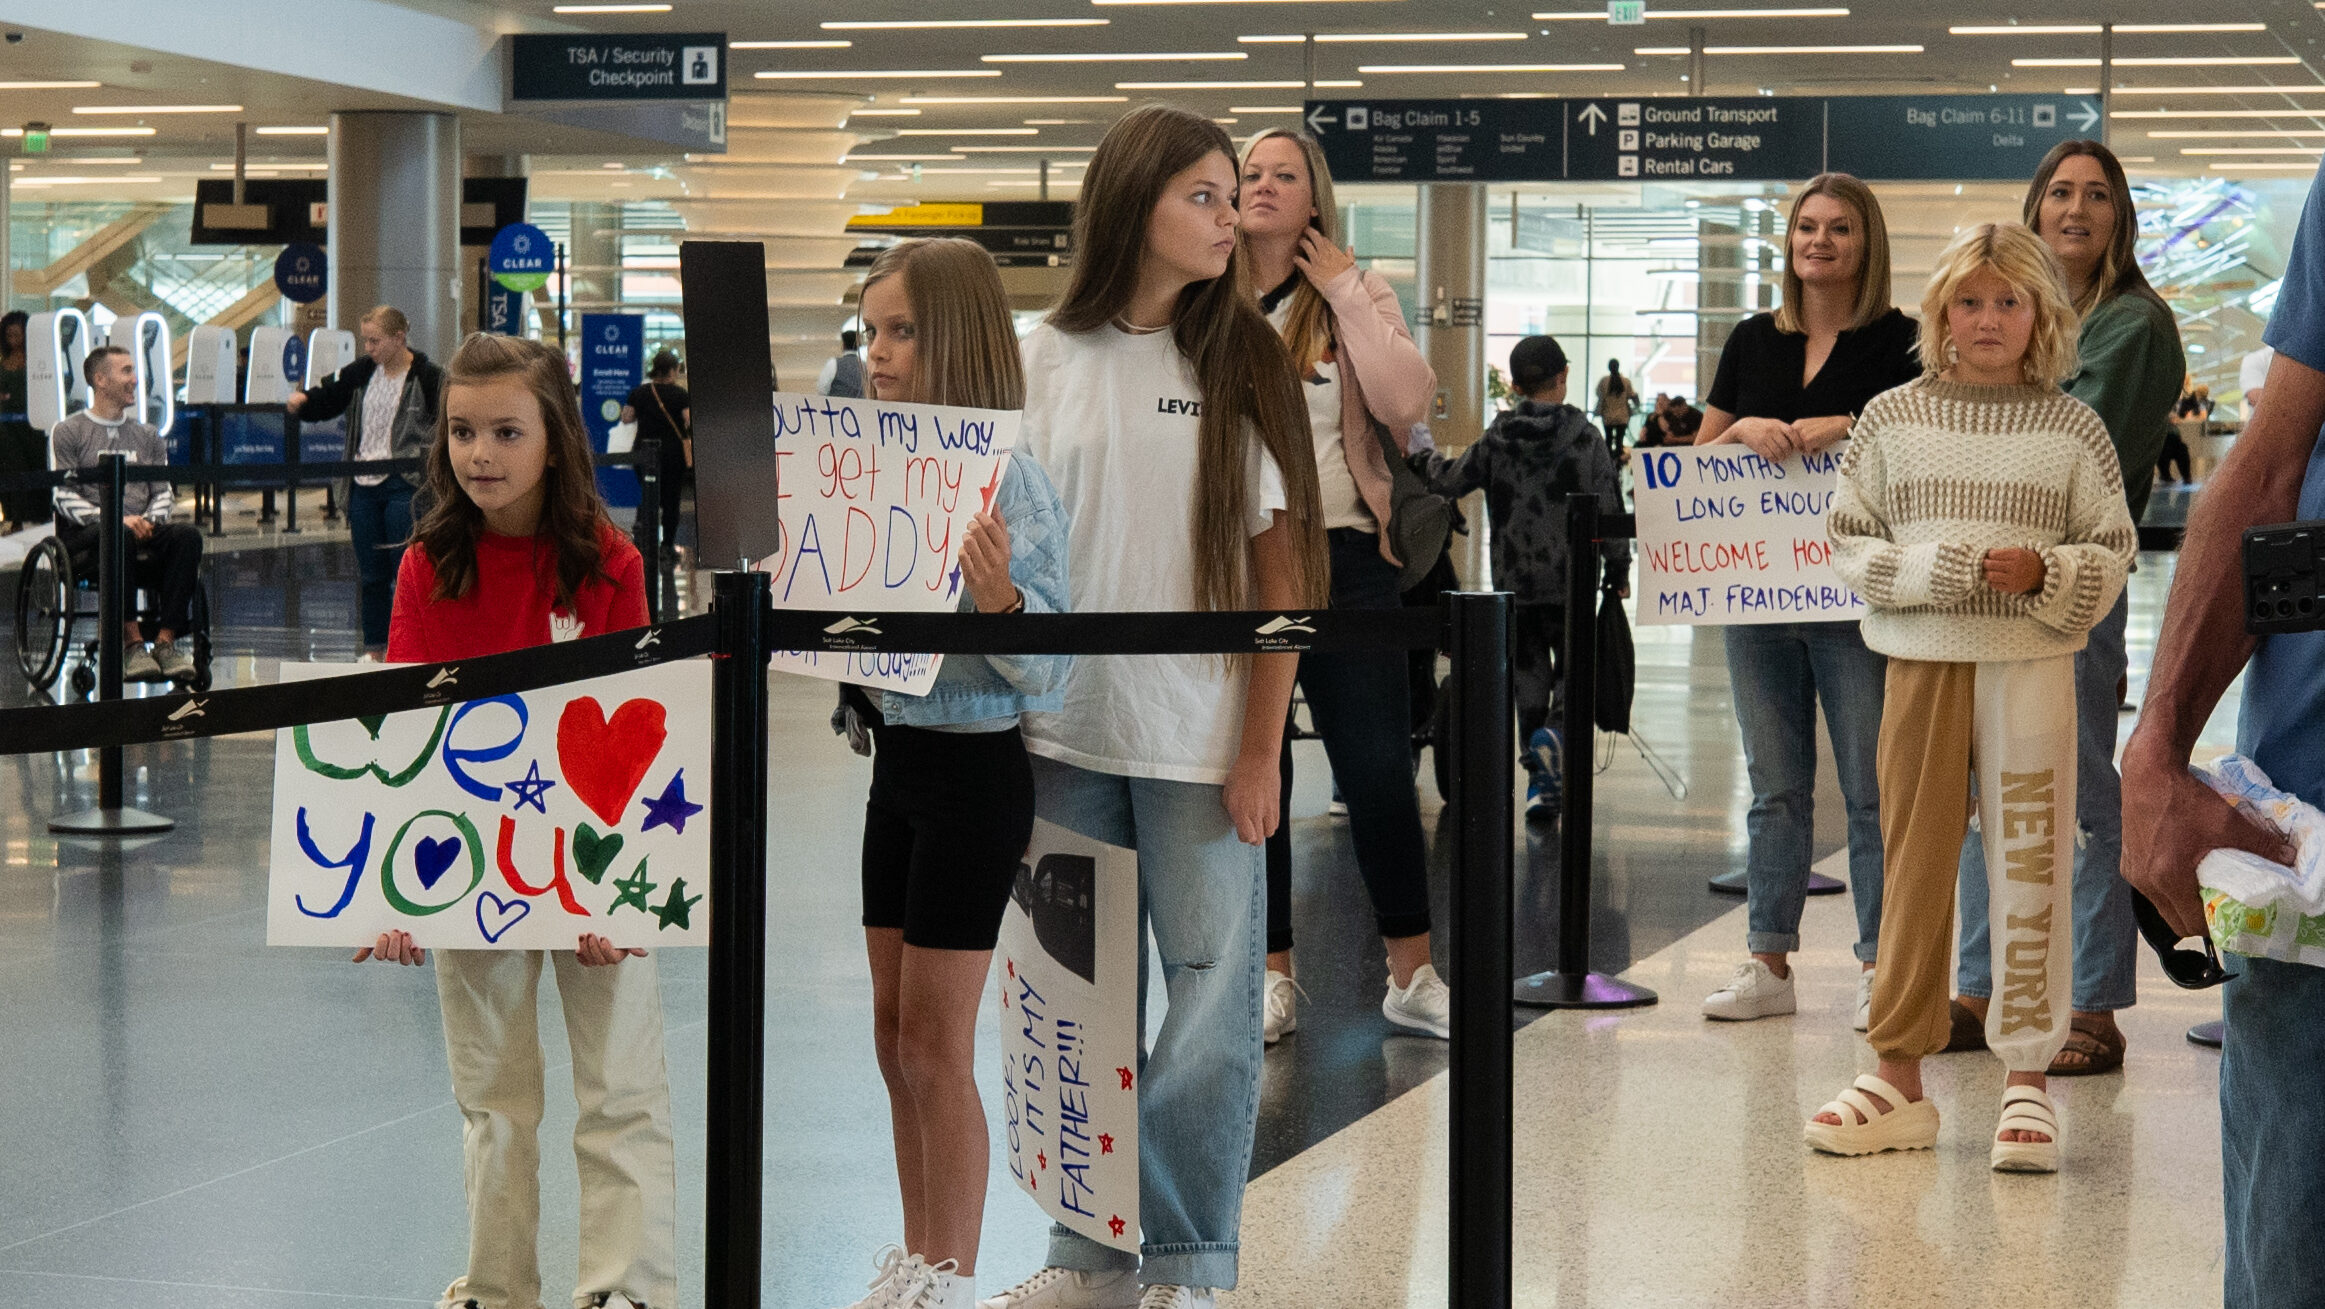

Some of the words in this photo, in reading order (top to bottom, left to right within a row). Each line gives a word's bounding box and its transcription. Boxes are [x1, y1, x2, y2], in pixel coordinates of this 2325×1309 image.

[567, 47, 599, 64] TSA
[601, 47, 609, 64] /
[612, 47, 675, 67] Security
[588, 69, 674, 88] Checkpoint
[1372, 110, 1402, 130] Bag
[1405, 109, 1449, 127] Claim
[1455, 110, 1481, 127] 1-5
[1645, 106, 1700, 123] Ground
[1706, 106, 1778, 126] Transport
[1907, 108, 1936, 127] Bag
[1941, 107, 1985, 124] Claim
[1990, 107, 2025, 124] 6-11
[1645, 132, 1702, 151] Parking
[1707, 132, 1761, 151] Garage
[1993, 134, 2024, 147] Delta
[1645, 157, 1694, 174] Rental
[1699, 157, 1734, 174] Cars
[503, 258, 542, 268] CLEAR
[287, 275, 319, 284] CLEAR
[491, 291, 508, 329] TSA
[595, 345, 628, 354] CLEAR
[877, 409, 917, 453] my
[818, 442, 881, 502] get
[906, 457, 962, 513] my
[1642, 452, 1682, 490] 10
[1696, 454, 1786, 484] MONTHS
[1676, 496, 1745, 522] LONG
[1760, 491, 1835, 515] ENOU
[1645, 540, 1769, 573] WELCOME
[1659, 587, 1714, 616] MAJ.
[2000, 767, 2055, 887] NEW
[296, 806, 592, 919] you
[1999, 902, 2054, 1036] YORK
[1019, 974, 1046, 1049] MY
